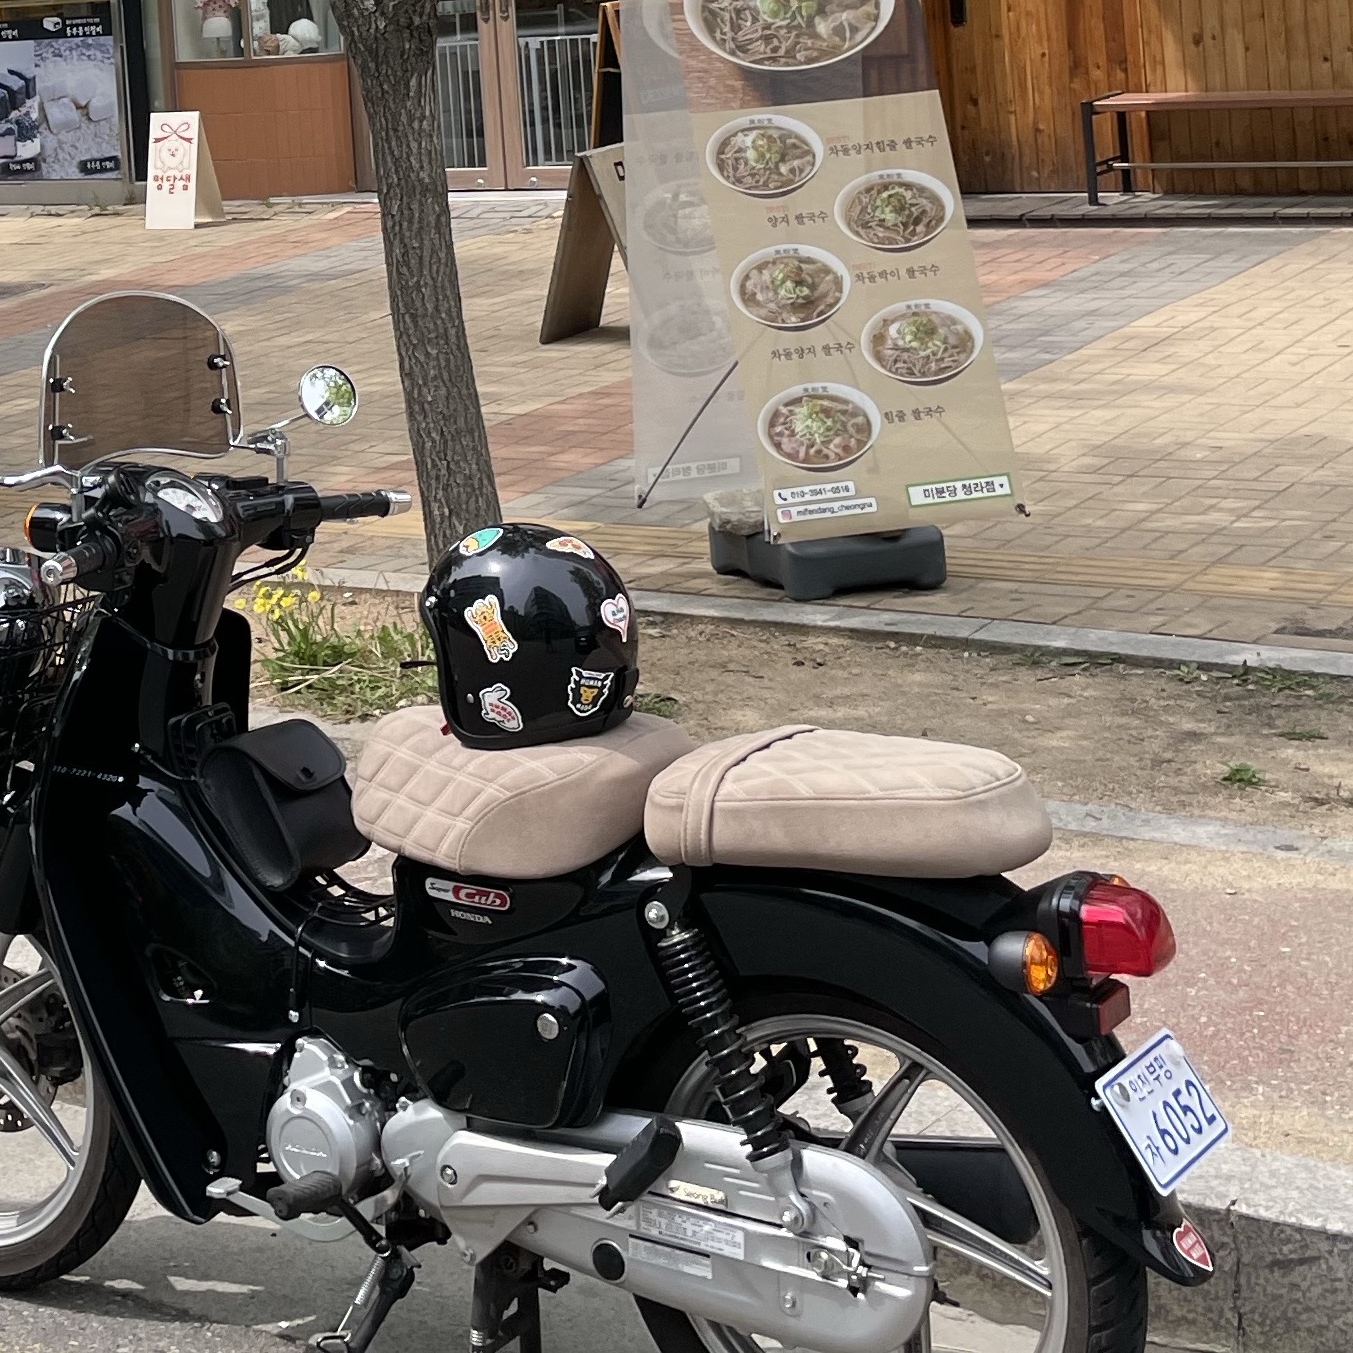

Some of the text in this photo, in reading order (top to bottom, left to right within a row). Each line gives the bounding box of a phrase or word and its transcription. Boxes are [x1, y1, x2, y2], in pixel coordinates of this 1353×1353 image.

[902, 134, 938, 150] 쌀국수
[153, 174, 191, 194] 멍달샘
[767, 210, 829, 229] 양지 쌀국수
[854, 264, 941, 284] 차돌박이 쌀국수
[821, 341, 856, 357] 쌀국수
[911, 404, 946, 421] 쌀국수
[923, 481, 996, 500] 미분당 청라점
[458, 887, 502, 906] Cub
[449, 908, 493, 925] HONDA
[1152, 1079, 1217, 1156] 6052
